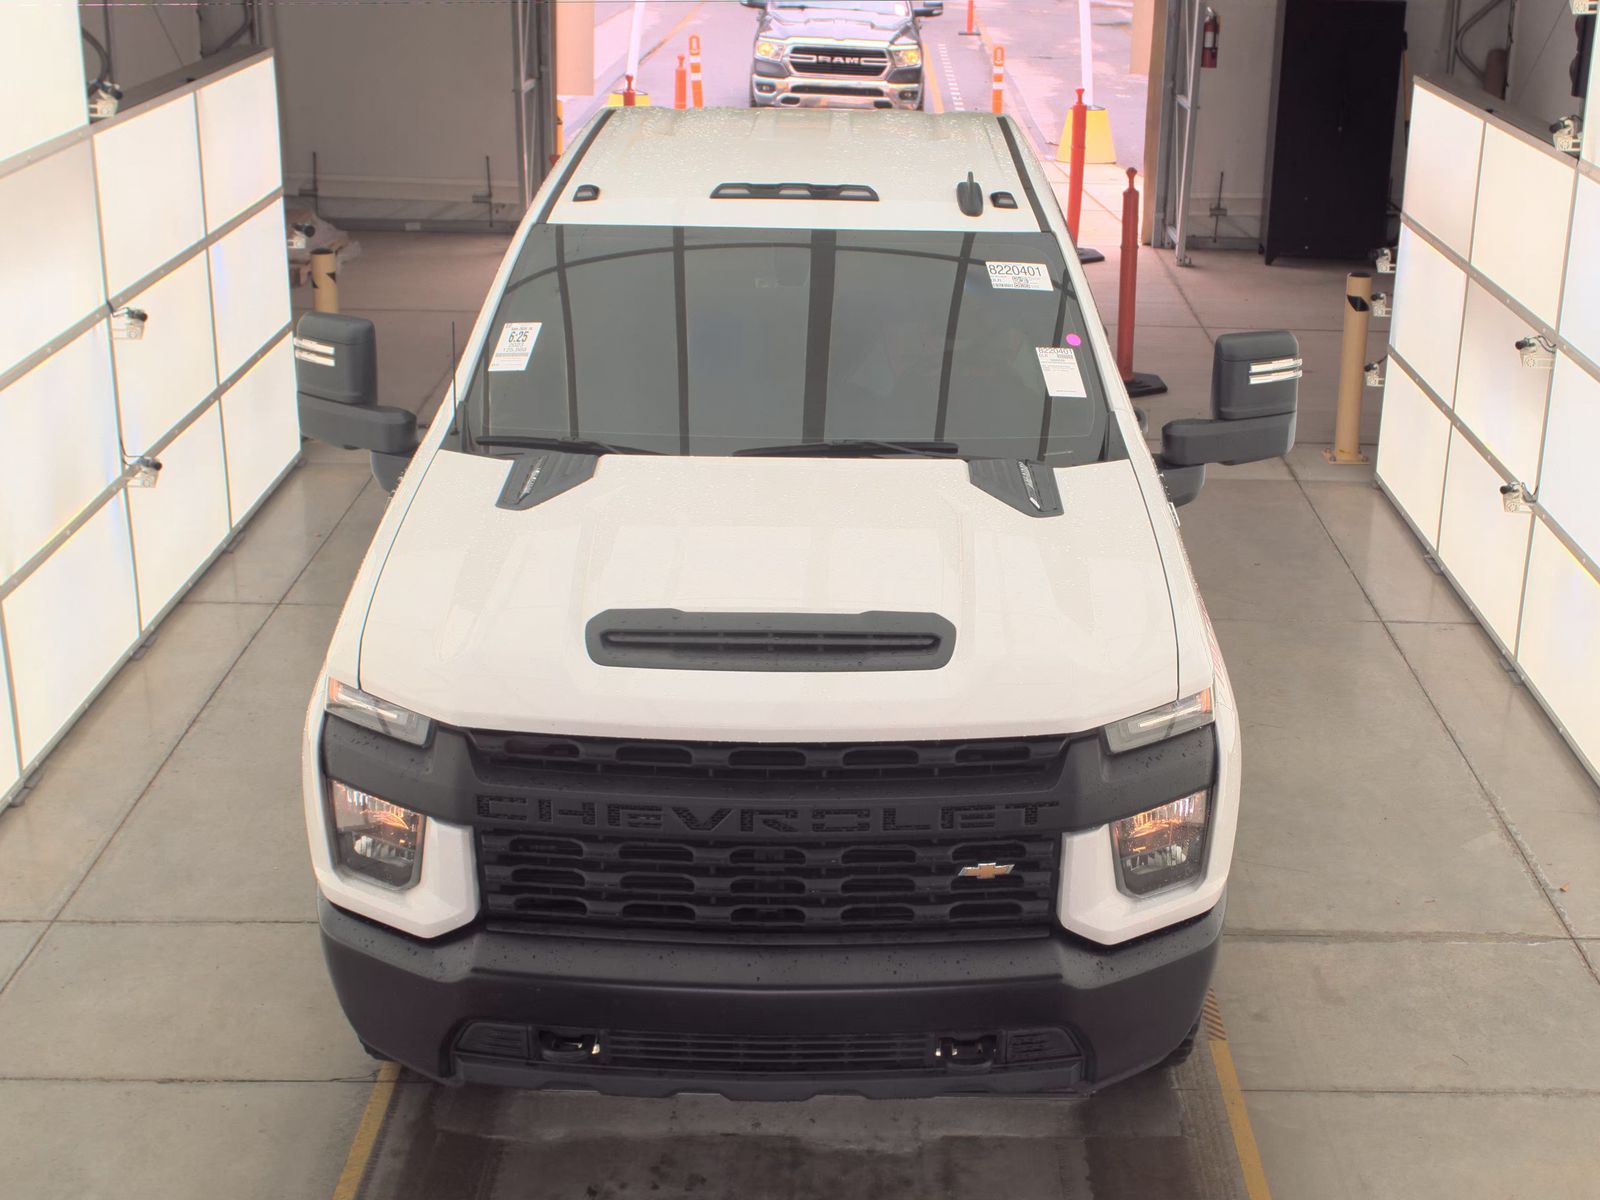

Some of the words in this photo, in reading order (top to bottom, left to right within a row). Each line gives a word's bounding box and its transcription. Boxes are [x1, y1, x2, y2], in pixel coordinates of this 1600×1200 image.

[818, 55, 859, 64] RAM
[989, 264, 1042, 277] 8220401
[475, 793, 1061, 833] CHEVROLET
